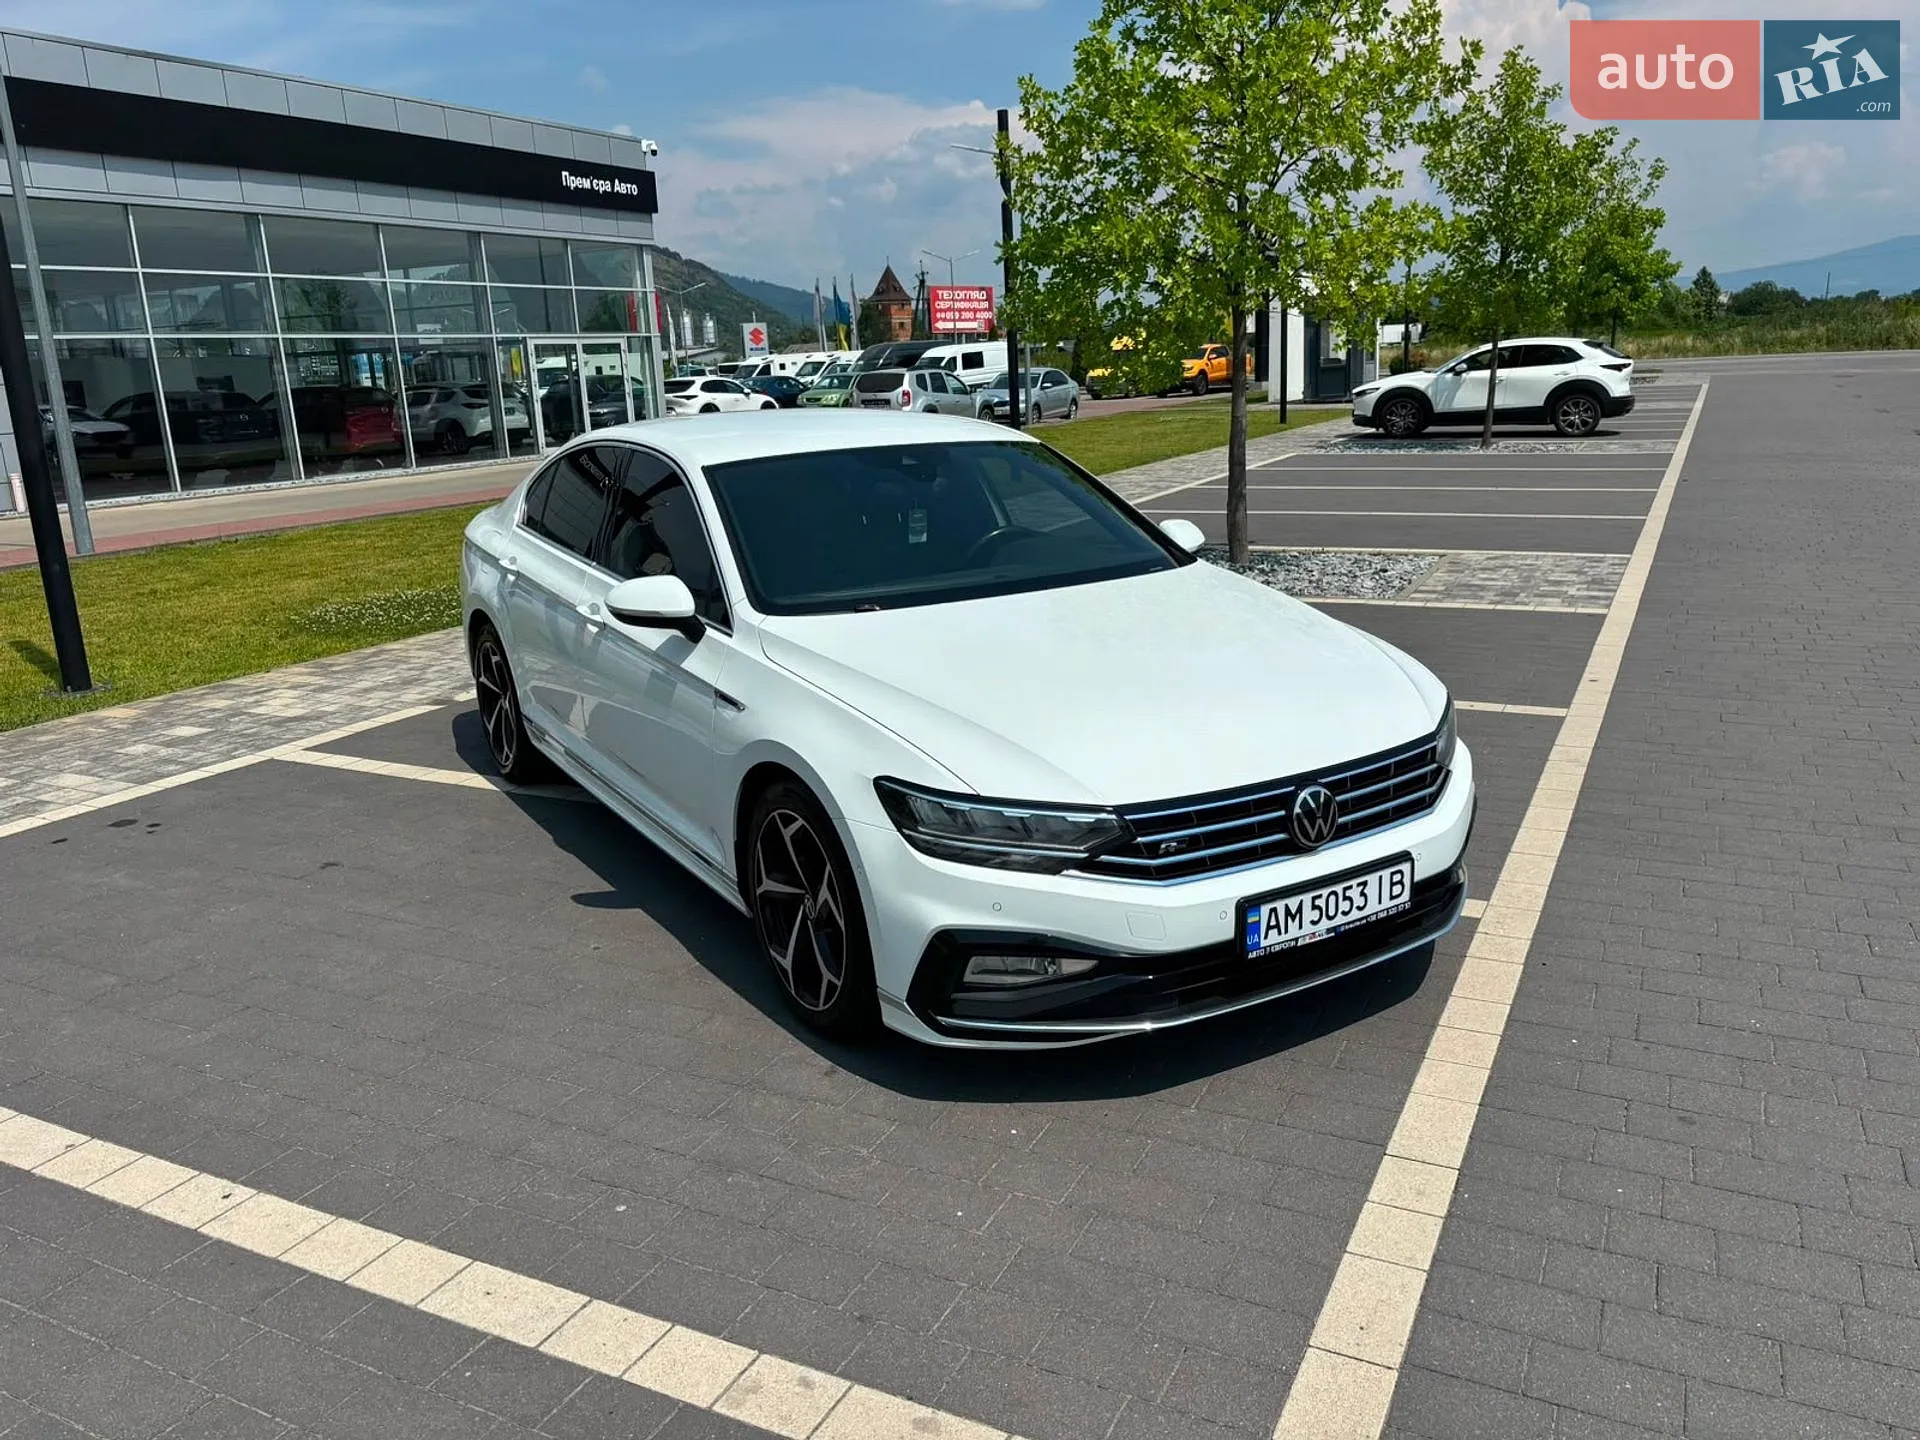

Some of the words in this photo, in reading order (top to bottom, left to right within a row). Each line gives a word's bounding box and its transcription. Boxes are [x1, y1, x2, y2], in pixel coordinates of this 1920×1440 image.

[561, 171, 611, 195] Прем'єра
[614, 178, 638, 196] Авто
[1263, 898, 1304, 941] AM
[1309, 879, 1369, 926] 5053
[1378, 868, 1405, 905] IB
[1246, 933, 1260, 945] UA
